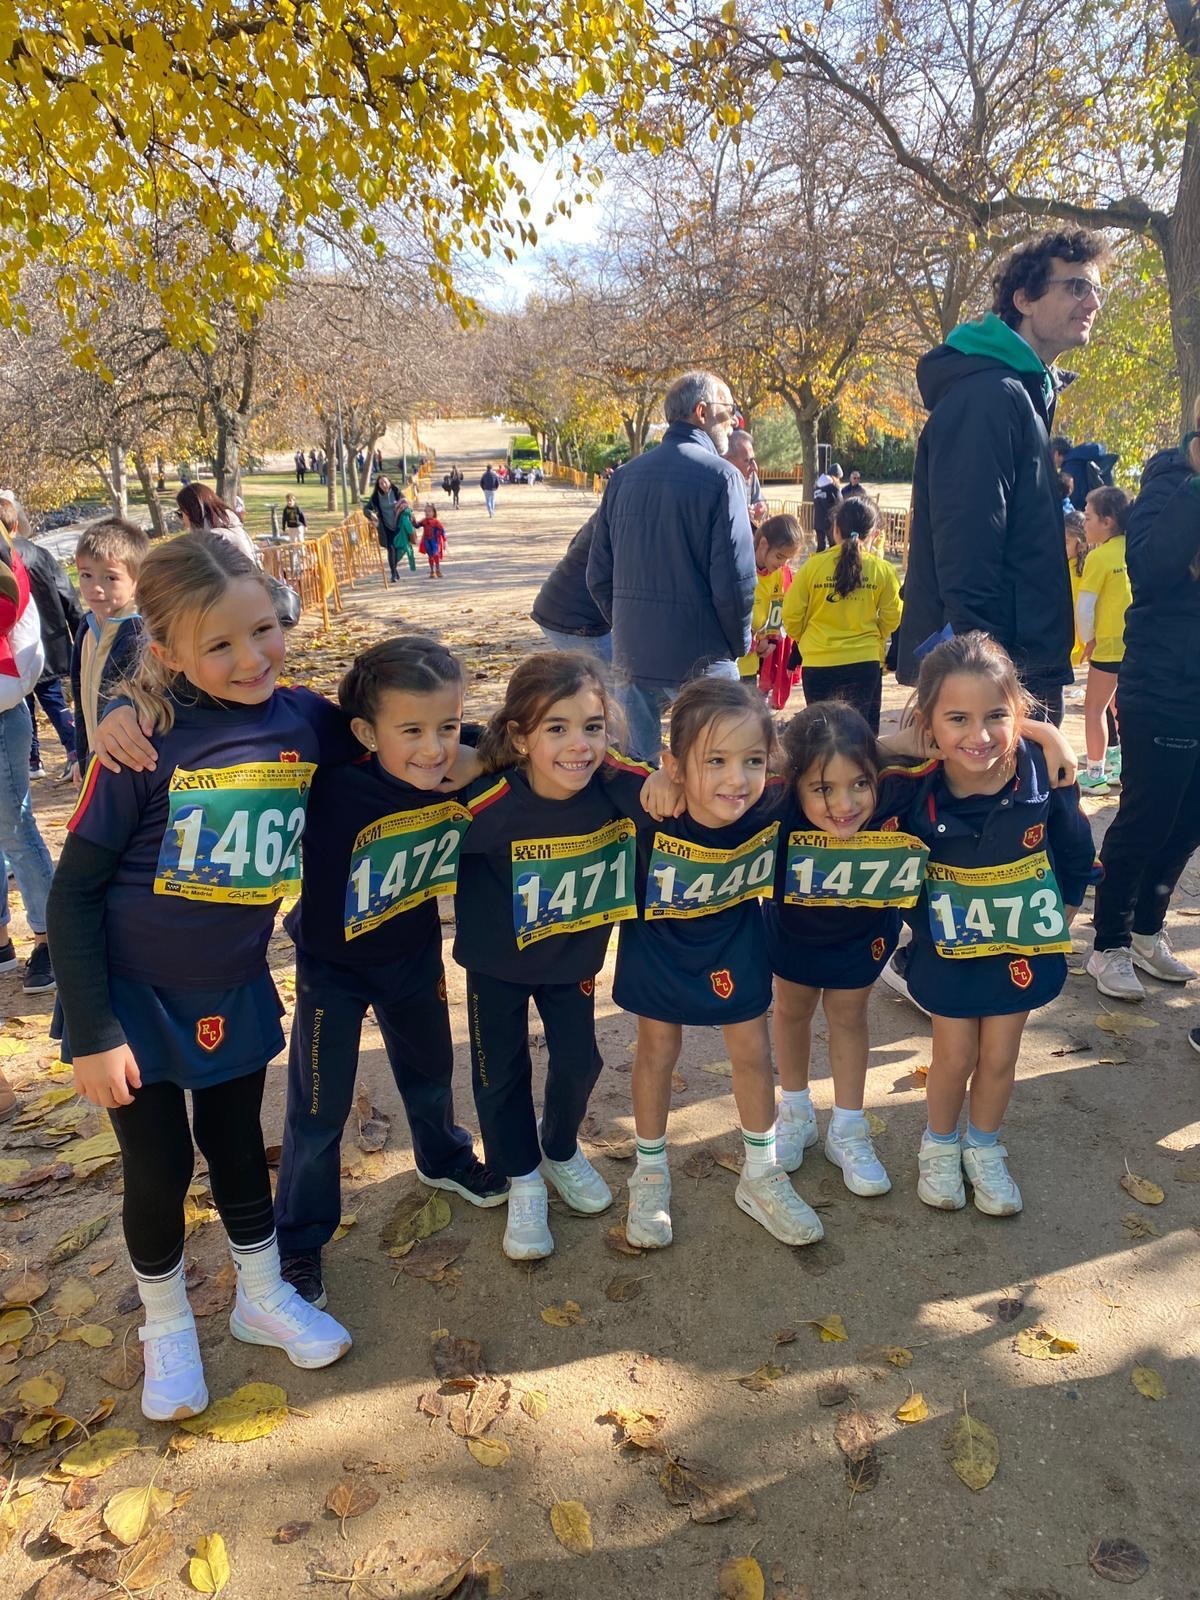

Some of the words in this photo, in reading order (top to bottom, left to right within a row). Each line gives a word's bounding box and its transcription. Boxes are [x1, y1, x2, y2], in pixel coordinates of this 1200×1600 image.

[172, 806, 306, 877] 1462
[515, 843, 551, 852] CROSS
[351, 829, 460, 913] 1472
[518, 850, 626, 923] 1471
[653, 849, 774, 903] 1440
[791, 856, 921, 895] 1474
[931, 888, 1064, 940] 1473
[202, 1023, 217, 1041] RC
[312, 1007, 324, 1071] RUNNYMEDE
[310, 1072, 320, 1116] COLLEGE
